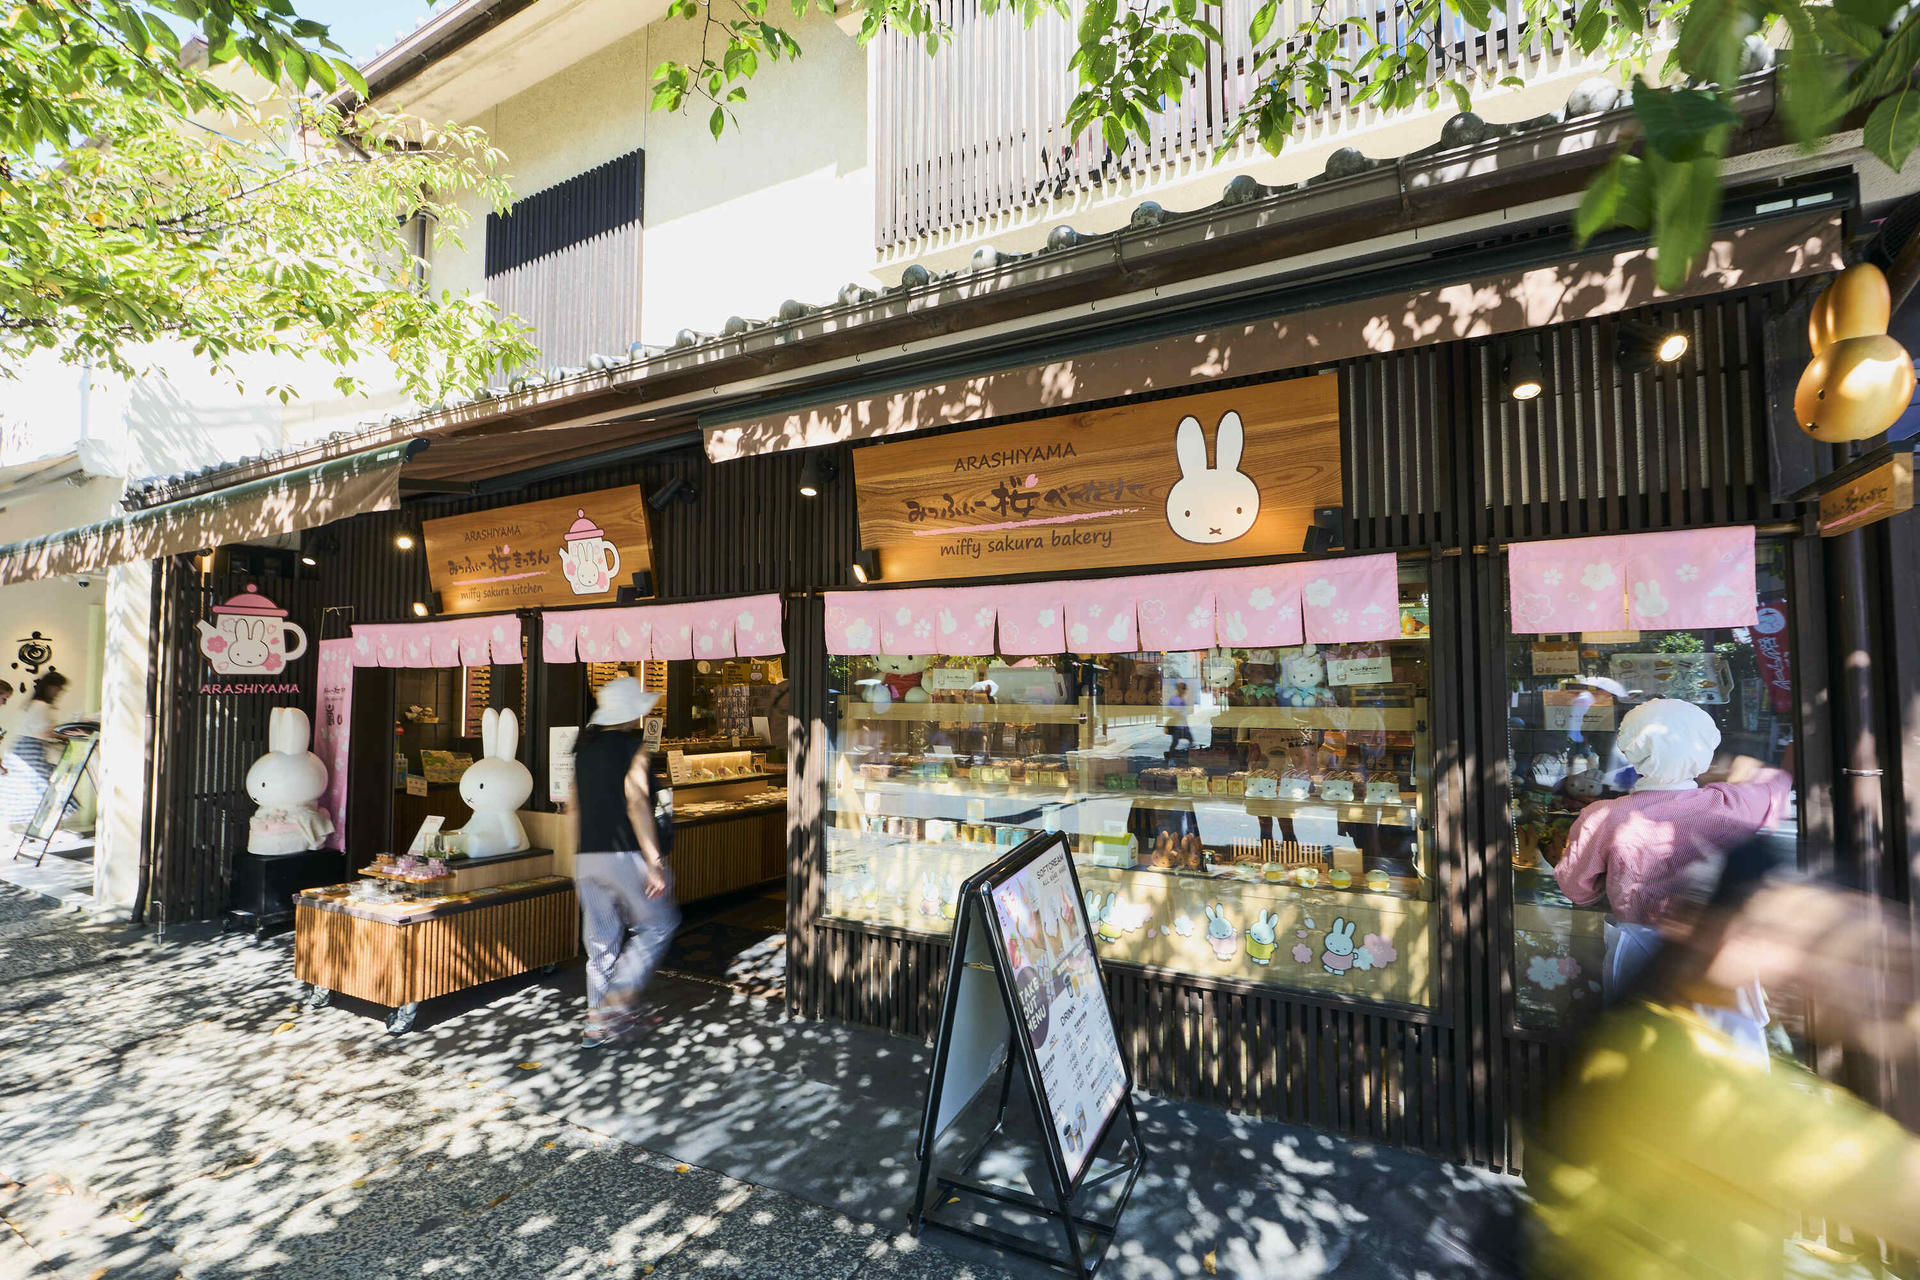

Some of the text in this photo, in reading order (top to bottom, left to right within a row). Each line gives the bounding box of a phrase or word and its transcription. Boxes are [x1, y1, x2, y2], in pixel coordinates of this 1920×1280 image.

[953, 442, 1077, 473] ARASHIYAMA
[464, 524, 521, 542] ARASHIYAMA
[940, 528, 1112, 559] miffy sakura bakery
[460, 583, 543, 602] miffy sakura kitchen
[200, 683, 301, 694] ARASHIYAMA
[1018, 976, 1040, 1001] TAKE
[1023, 997, 1039, 1020] OUT
[1026, 1003, 1047, 1033] MENU
[1060, 1003, 1076, 1027] DRINK
